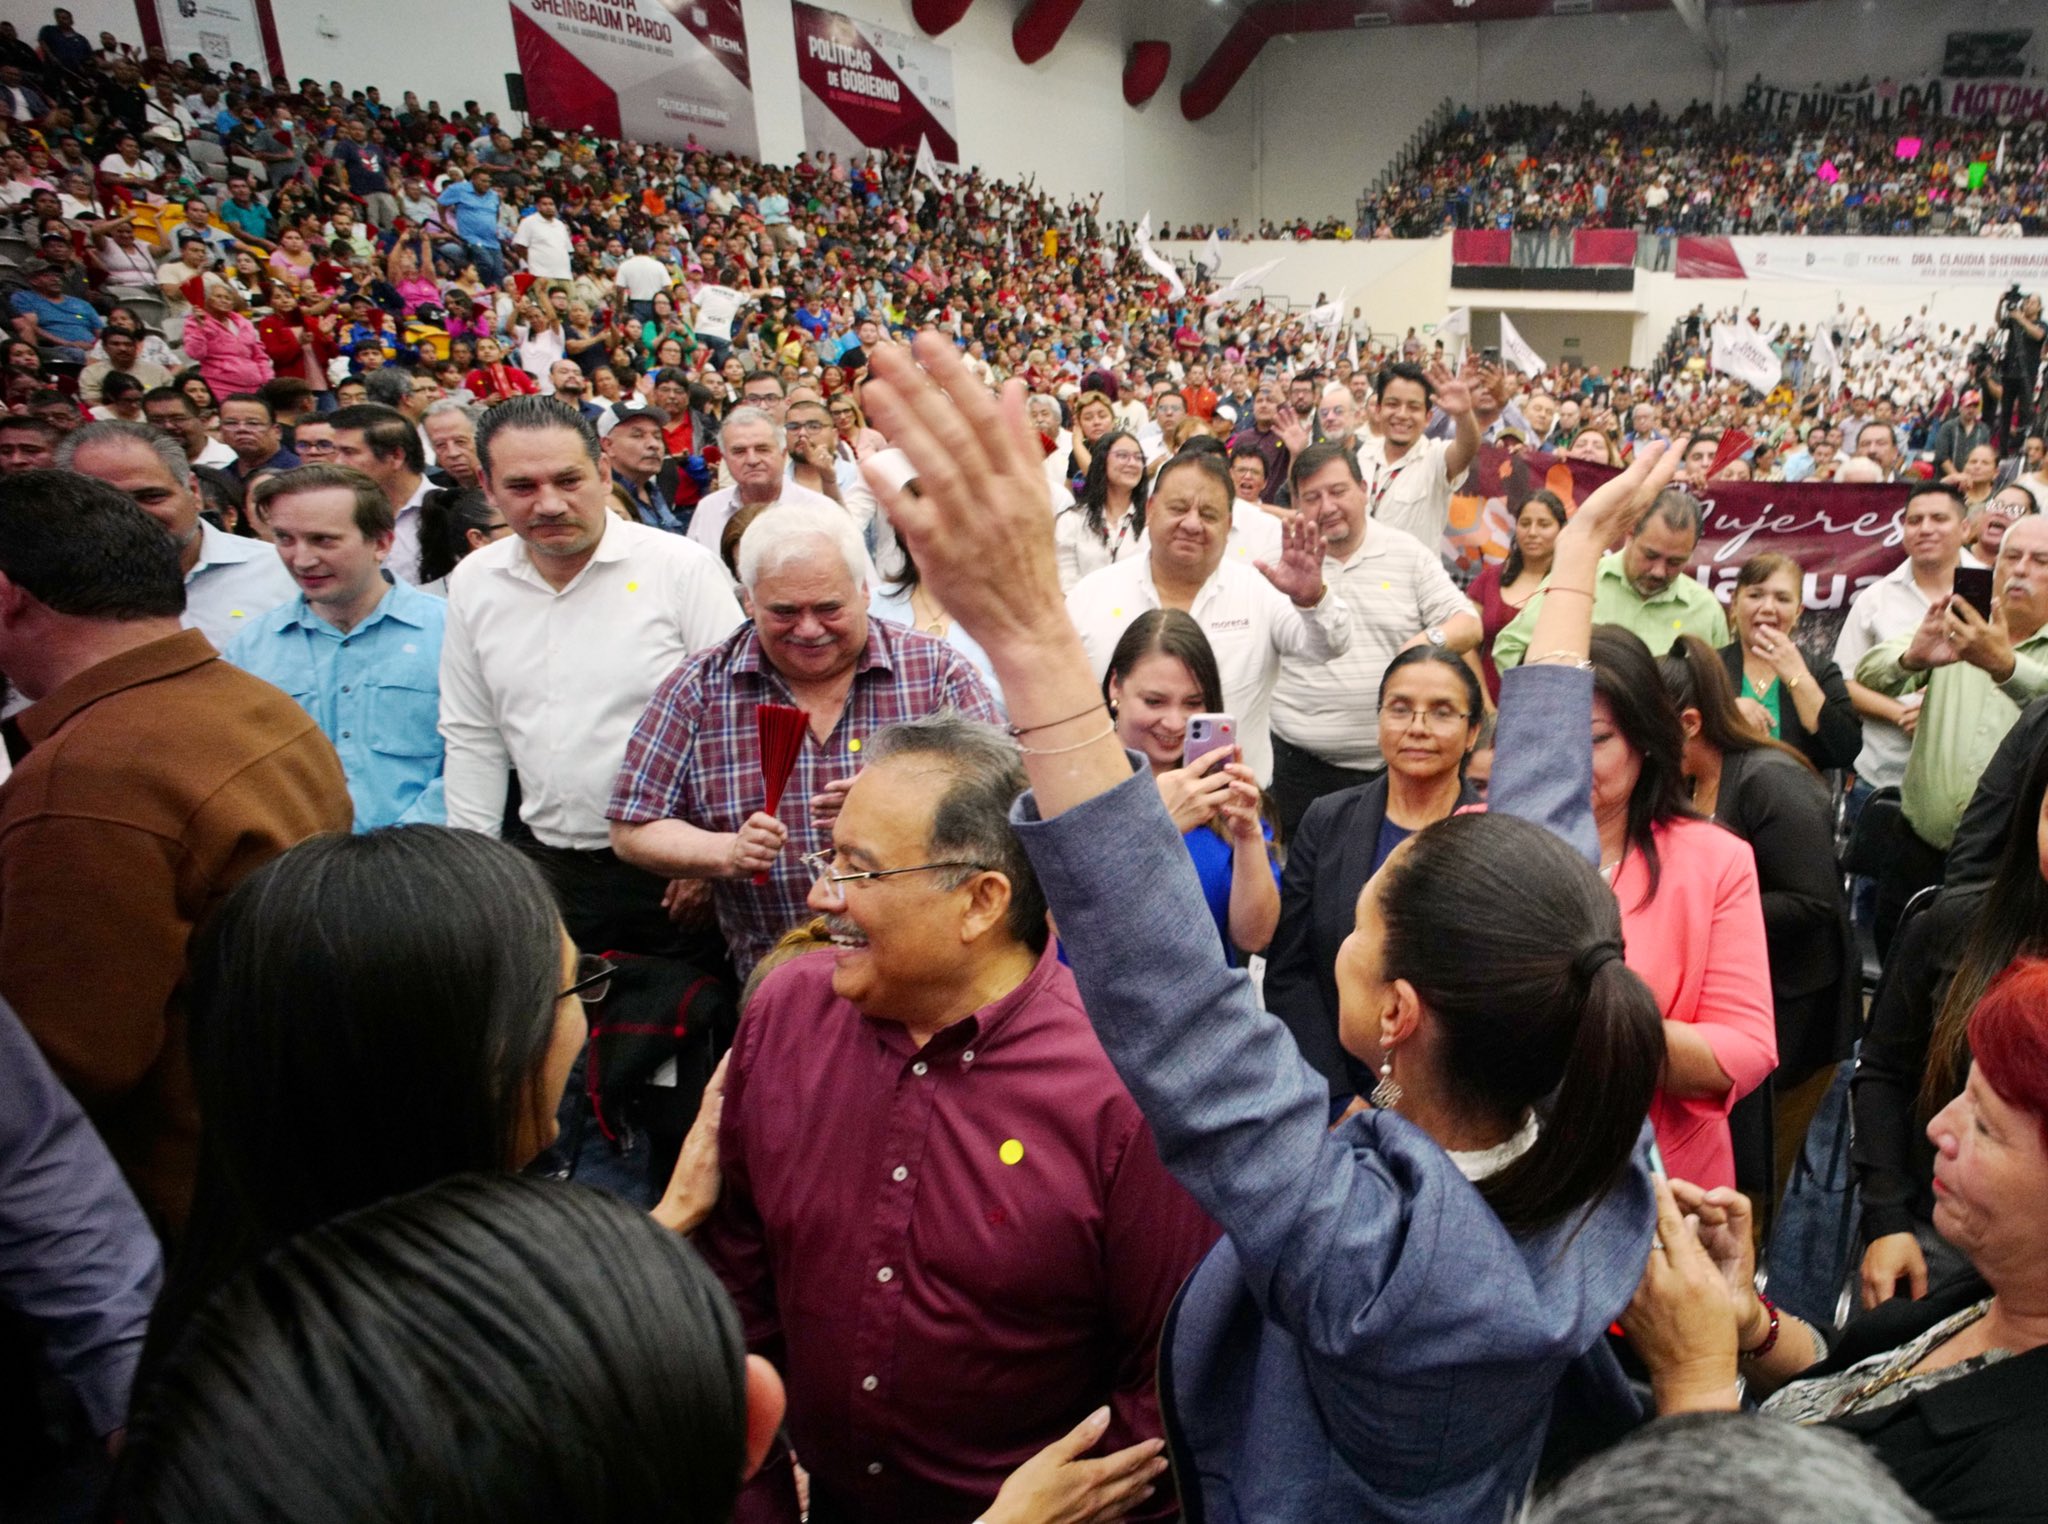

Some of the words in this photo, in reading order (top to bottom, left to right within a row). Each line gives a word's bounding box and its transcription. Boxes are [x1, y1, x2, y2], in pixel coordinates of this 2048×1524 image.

[626, 13, 672, 44] PARDO
[808, 35, 872, 73] POLÍTICAS
[827, 70, 839, 87] DE
[840, 68, 900, 102] GOBIERNO
[1939, 253, 1985, 265] CLAUDIA
[1664, 482, 1906, 562] ujeres
[1211, 618, 1249, 629] morena
